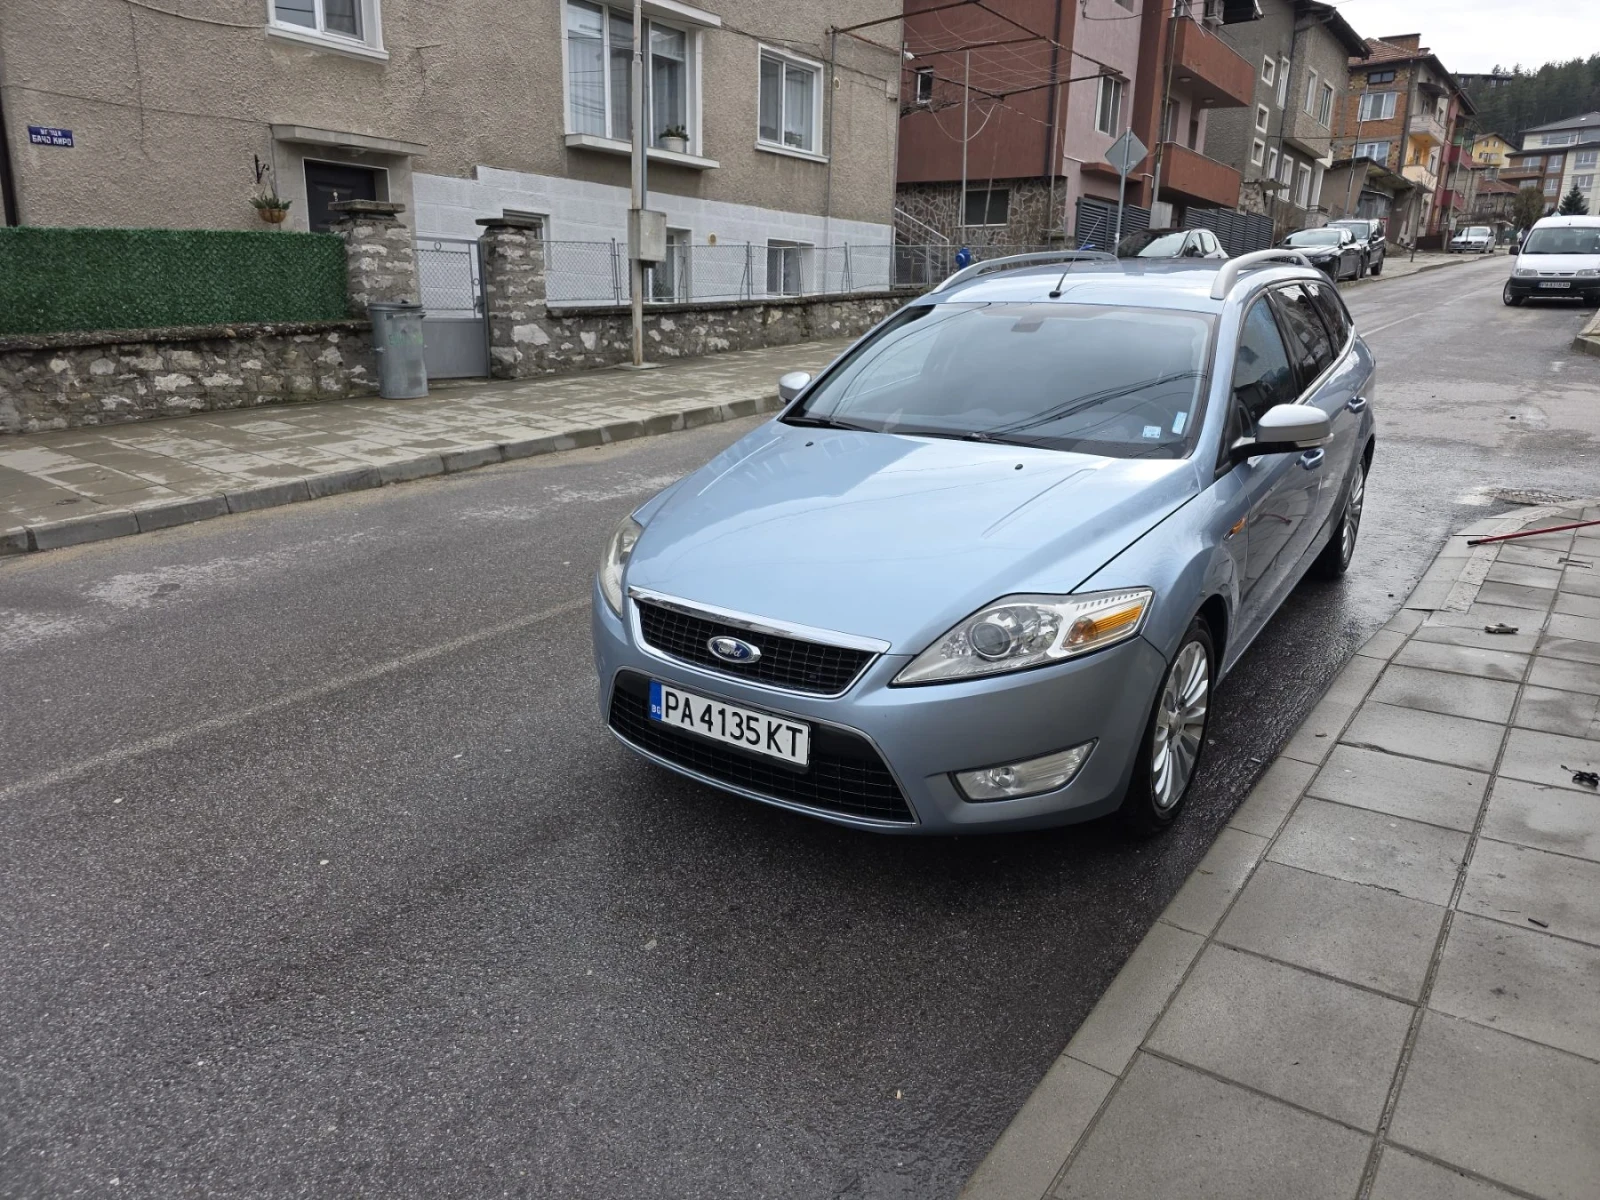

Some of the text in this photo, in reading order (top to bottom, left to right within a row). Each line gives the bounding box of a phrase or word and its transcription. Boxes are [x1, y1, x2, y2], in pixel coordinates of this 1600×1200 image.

[52, 137, 72, 146] КИРО
[651, 704, 662, 715] BG
[665, 690, 803, 757] PA 4135 KT
